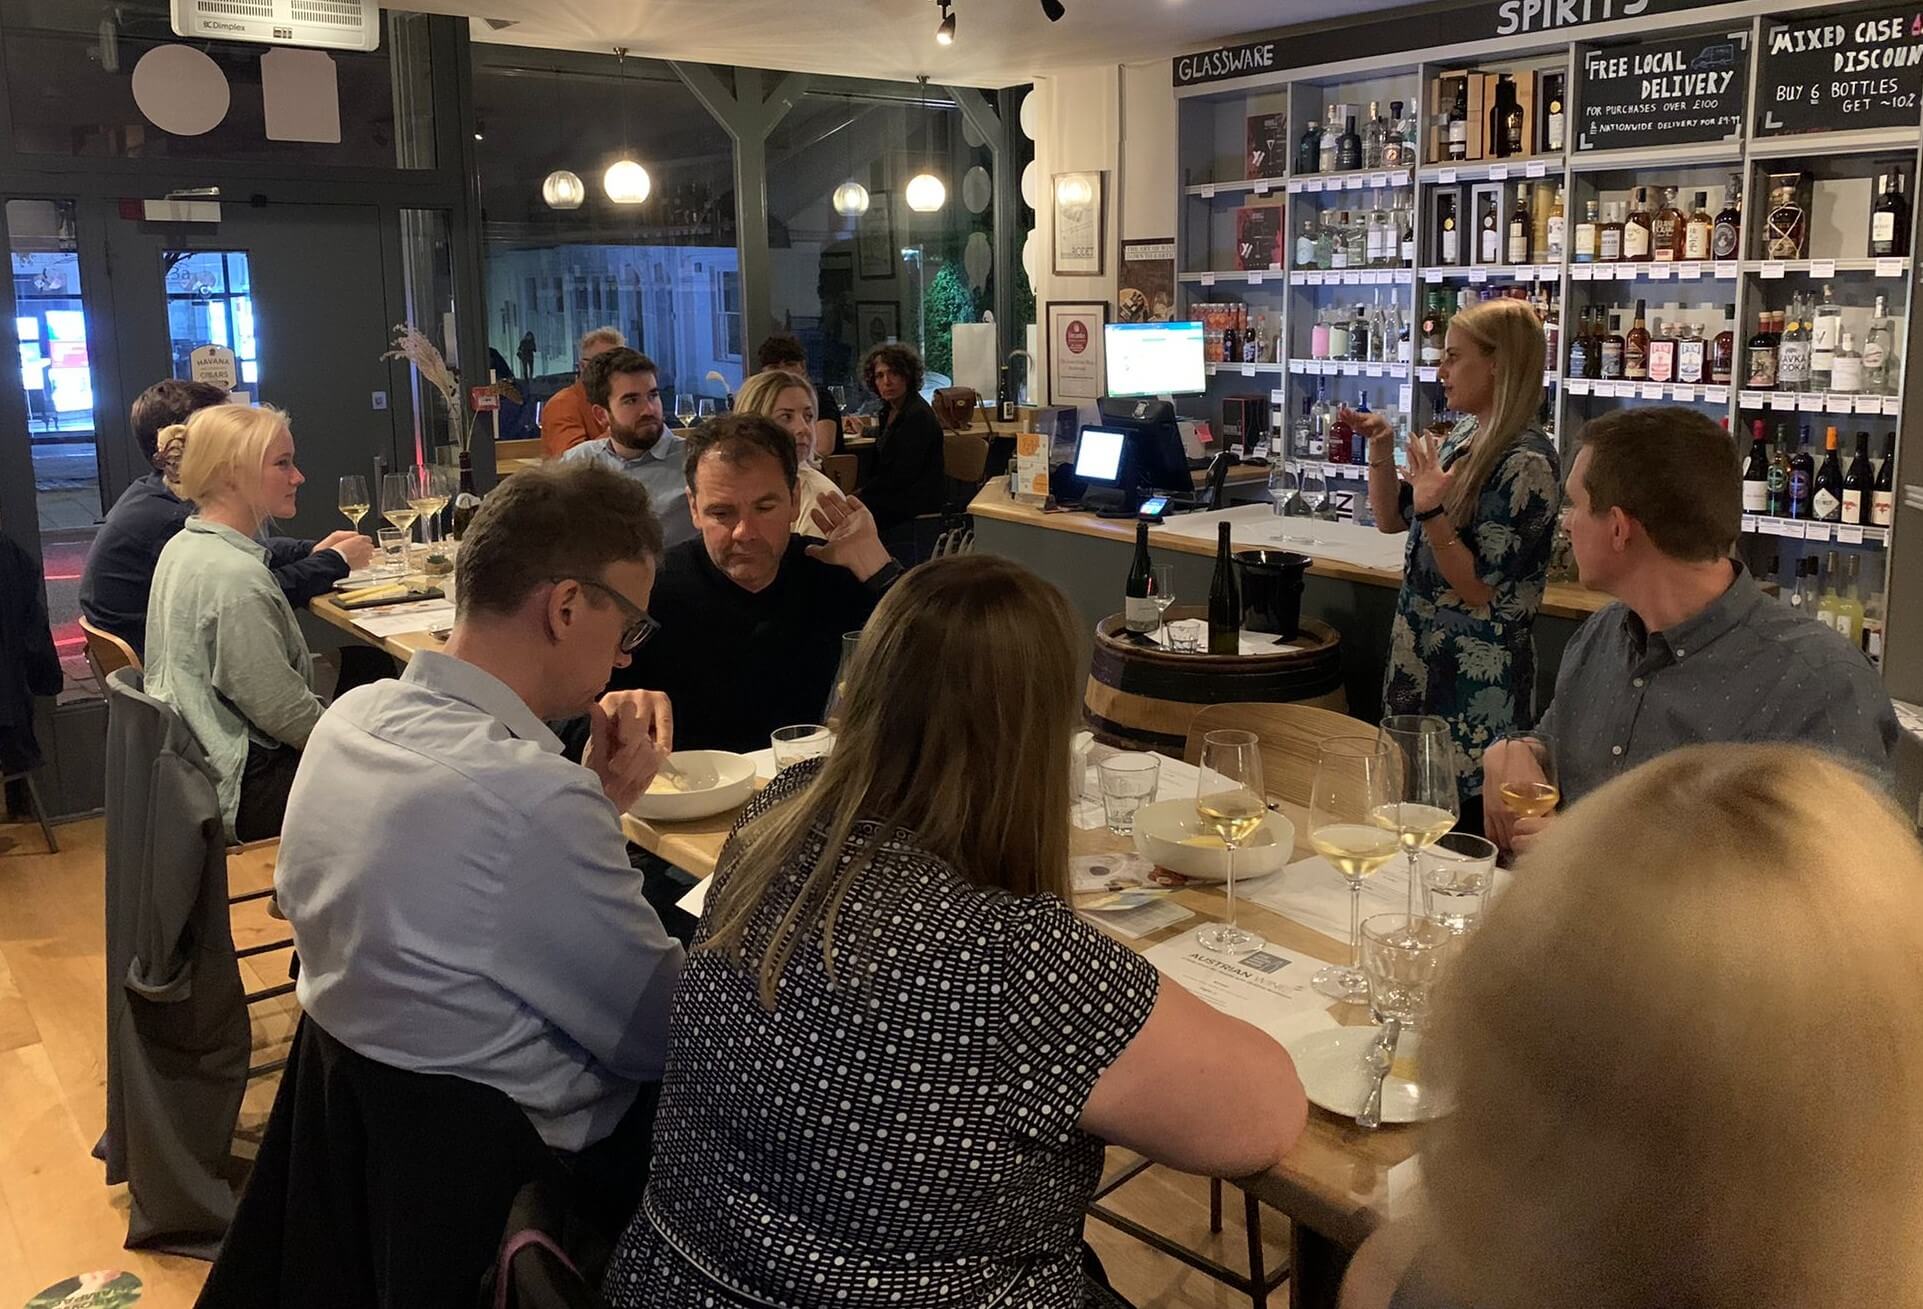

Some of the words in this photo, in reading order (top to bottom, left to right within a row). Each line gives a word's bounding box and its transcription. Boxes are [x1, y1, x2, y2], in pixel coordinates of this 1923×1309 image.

[212, 21, 246, 32] Dimplex
[1770, 25, 1846, 56] MIXED
[1854, 17, 1904, 44] CASE
[1178, 44, 1275, 81] GLASSWARE
[1589, 57, 1628, 80] FREE
[1634, 50, 1687, 76] LOCAL
[1640, 70, 1735, 100] DELIVERY
[1776, 85, 1805, 101] BUY
[1810, 83, 1820, 99] 6
[1831, 78, 1899, 98] BOTTLES
[1586, 105, 1603, 117] FOR
[1605, 103, 1657, 115] PURCHASES
[1663, 101, 1687, 112] OVER
[1692, 99, 1719, 110] £100
[1842, 98, 1872, 113] GET
[1599, 121, 1653, 134] NATIONWIDE
[1657, 119, 1699, 130] DELIVERY
[1700, 117, 1716, 127] FOR
[196, 358, 231, 366] HAVANA
[1188, 953, 1253, 979] AUSTRIAN
